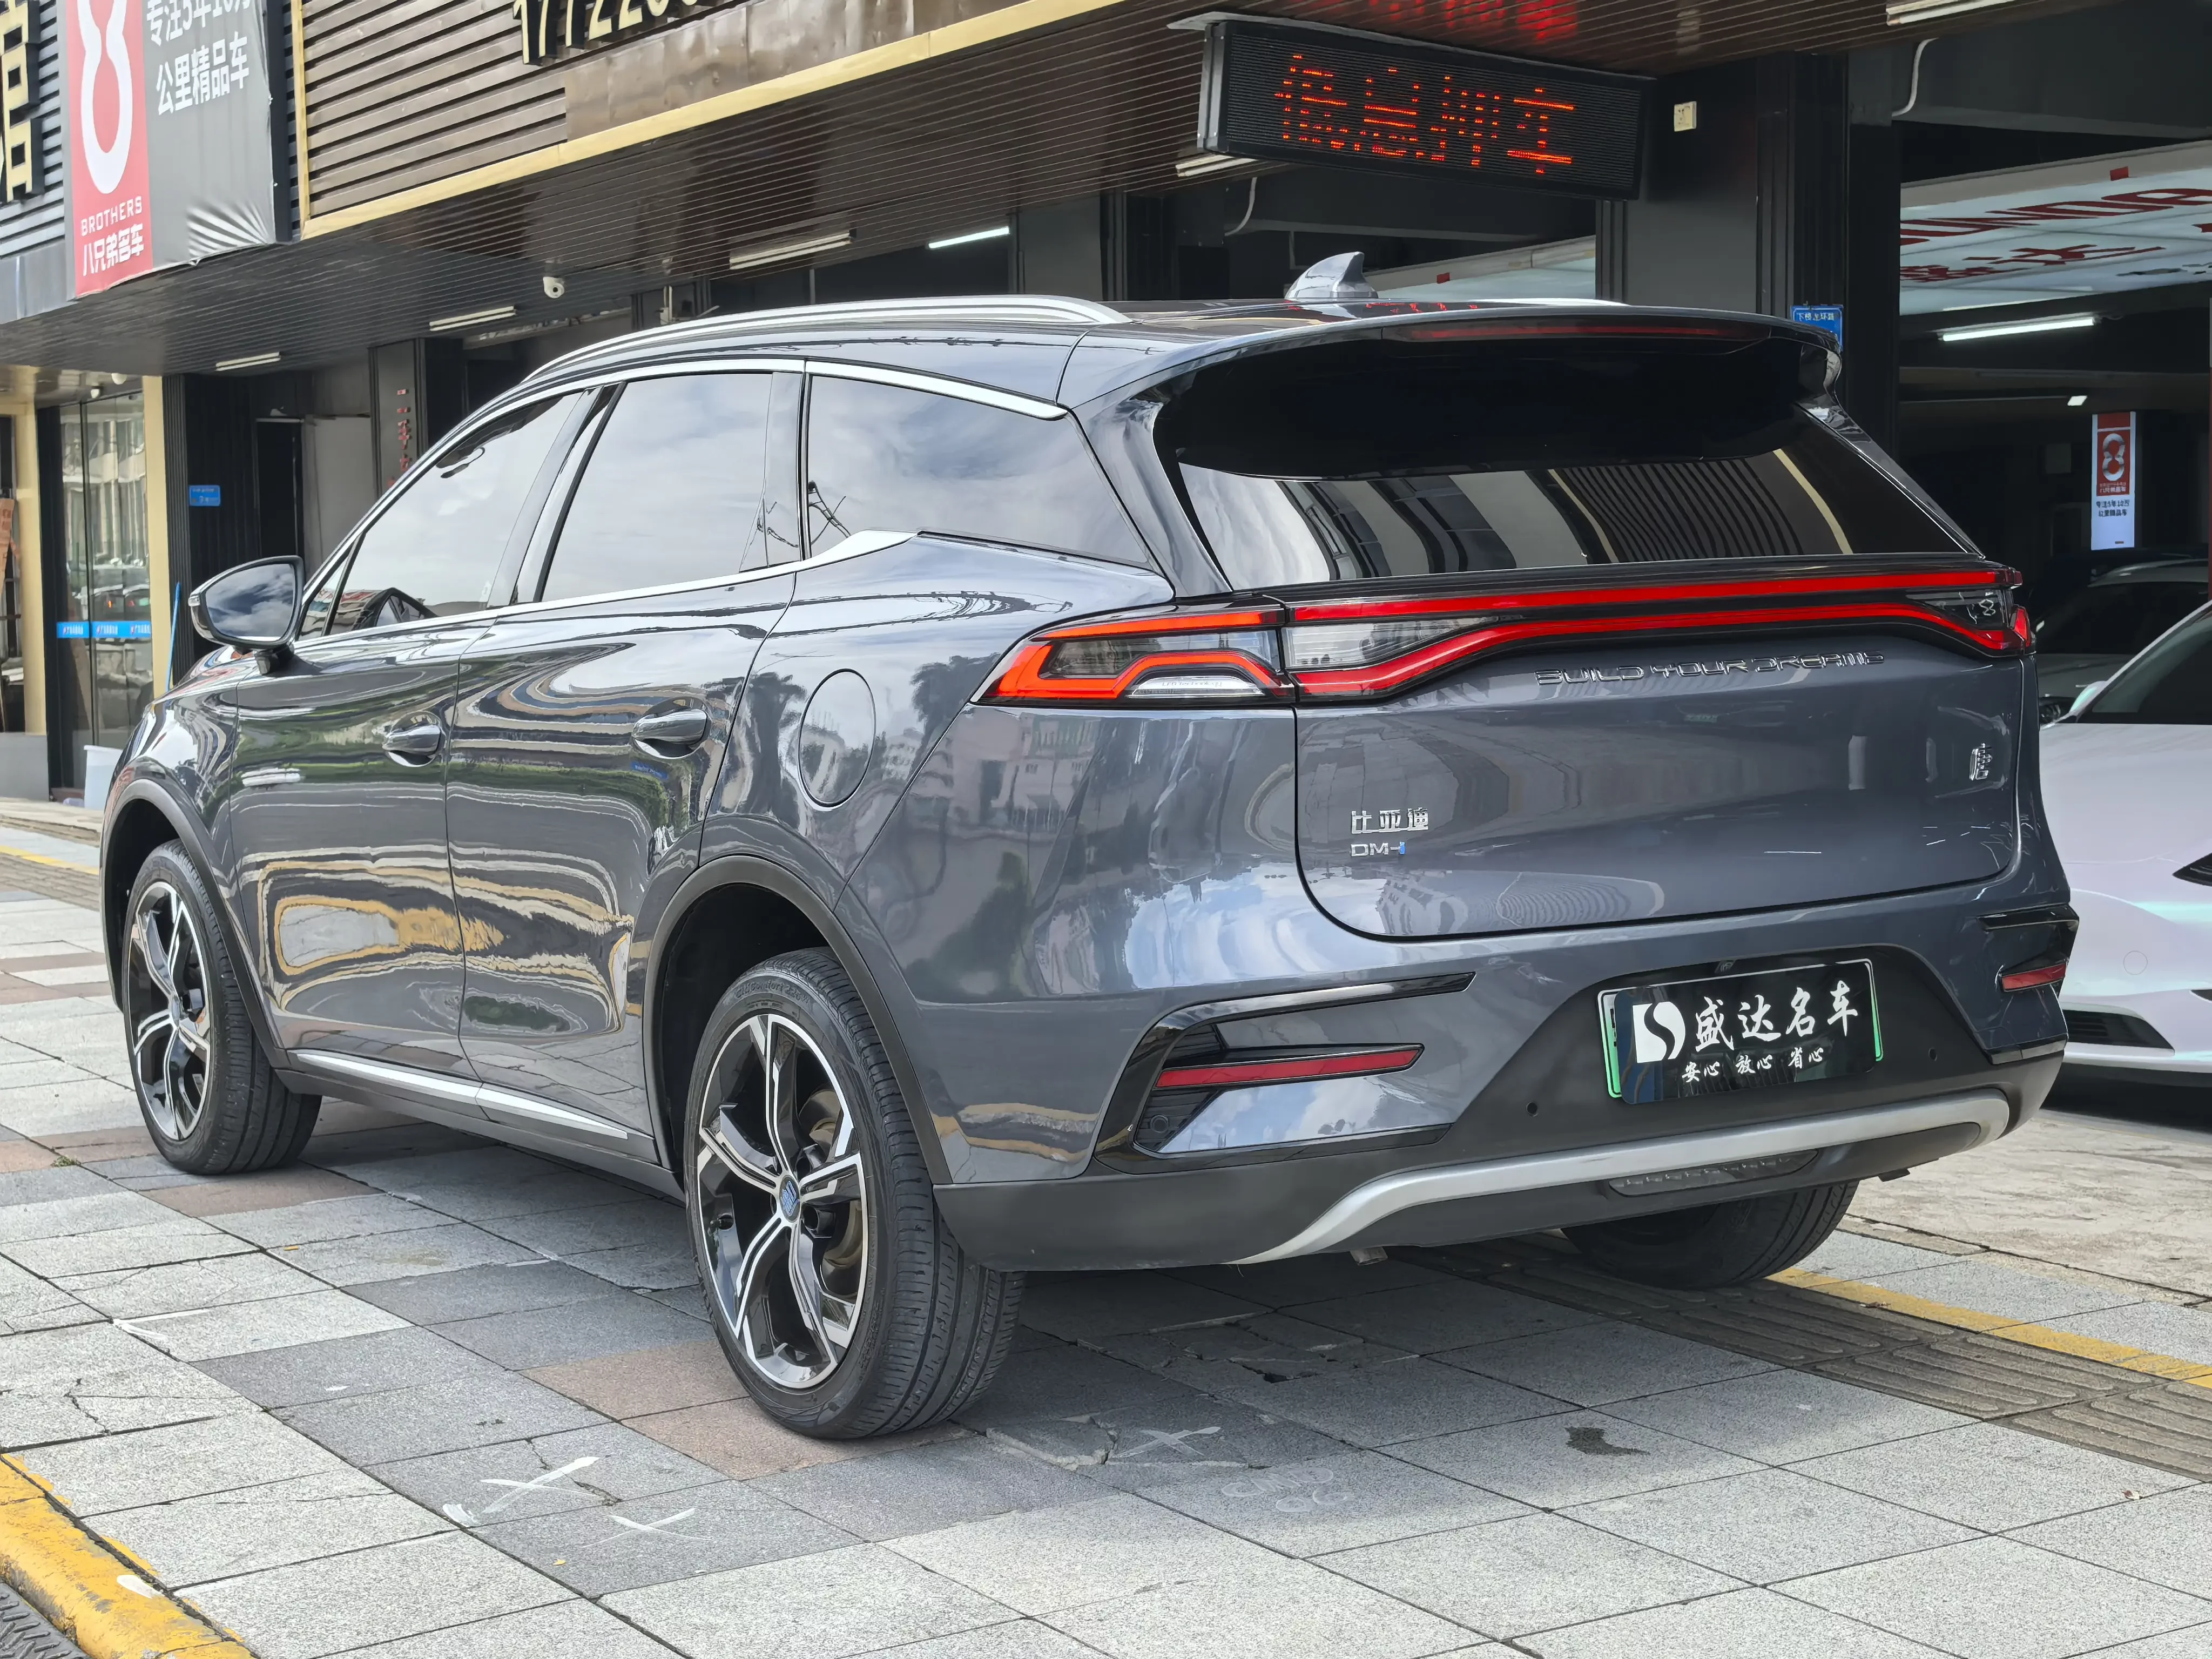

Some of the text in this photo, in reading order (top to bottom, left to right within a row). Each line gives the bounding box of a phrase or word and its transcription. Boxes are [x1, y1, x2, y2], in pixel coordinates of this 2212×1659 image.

[156, 31, 249, 116] 公里精品车
[81, 195, 143, 237] BROTHERS
[1534, 651, 1885, 685] BUILD YOUR DREAMS
[1351, 807, 1429, 834] 比亚迪
[1351, 841, 1406, 857] DM-i
[1695, 980, 1859, 1053] 盛达名车
[1735, 1055, 1773, 1074] 放心
[1788, 1047, 1824, 1069] 省心
